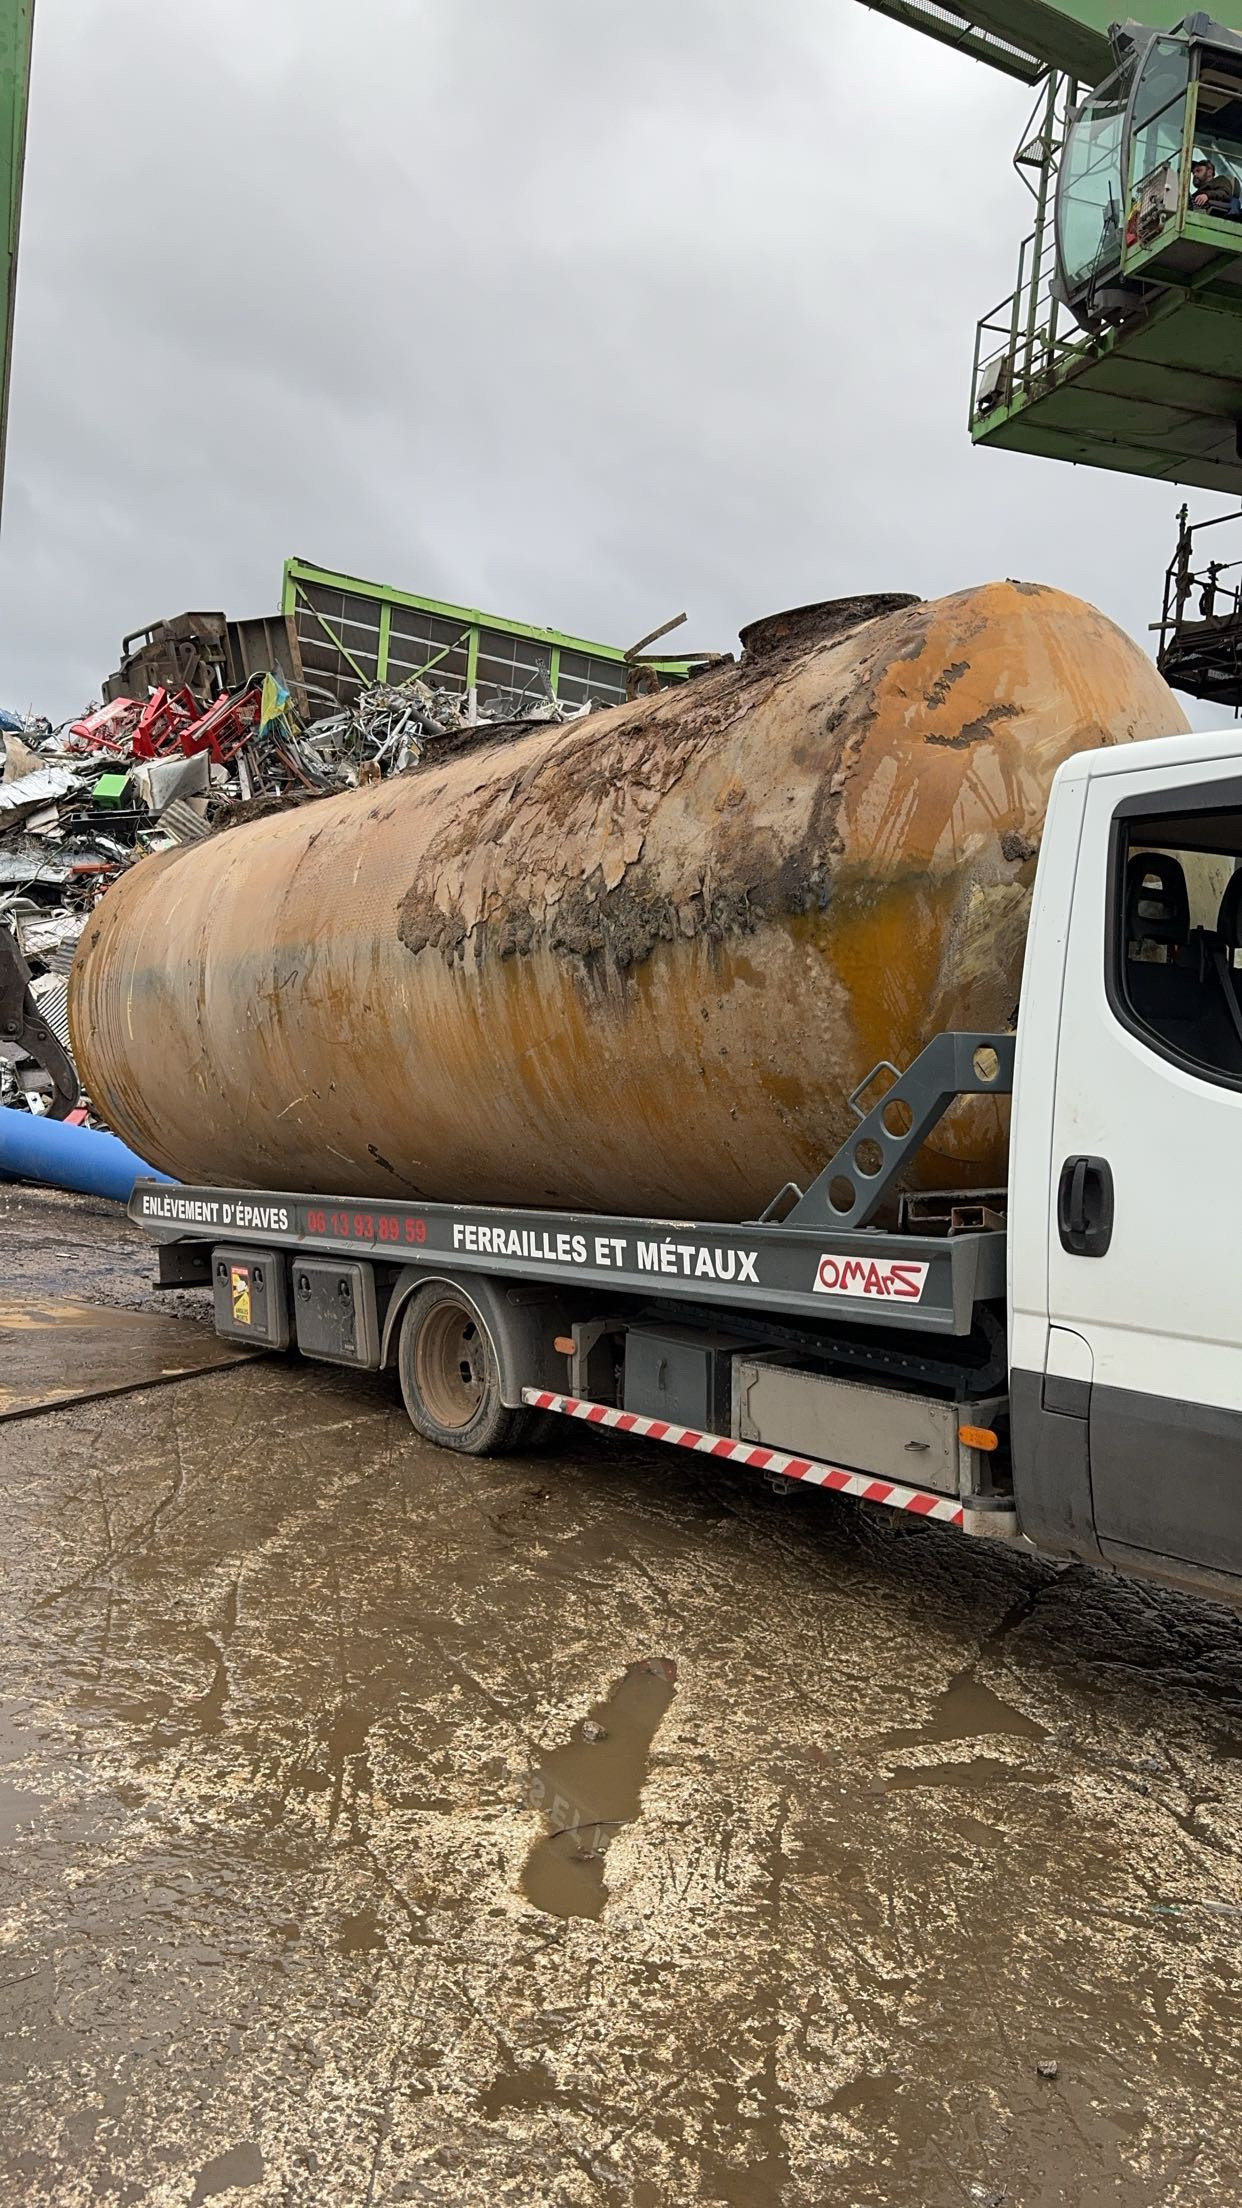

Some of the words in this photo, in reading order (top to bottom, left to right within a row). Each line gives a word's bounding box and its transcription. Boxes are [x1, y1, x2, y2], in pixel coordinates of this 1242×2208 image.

[143, 1194, 219, 1222] ENLÈVEMENT
[222, 1201, 288, 1230] D'ÉPAVES
[306, 1209, 327, 1232] 06
[331, 1210, 349, 1237] 13
[353, 1213, 374, 1238] 93
[378, 1215, 400, 1240] 89
[404, 1217, 426, 1244] 59
[453, 1223, 587, 1263] FERRAILLES
[594, 1237, 627, 1267] ET
[637, 1237, 760, 1283] MÉTAUX
